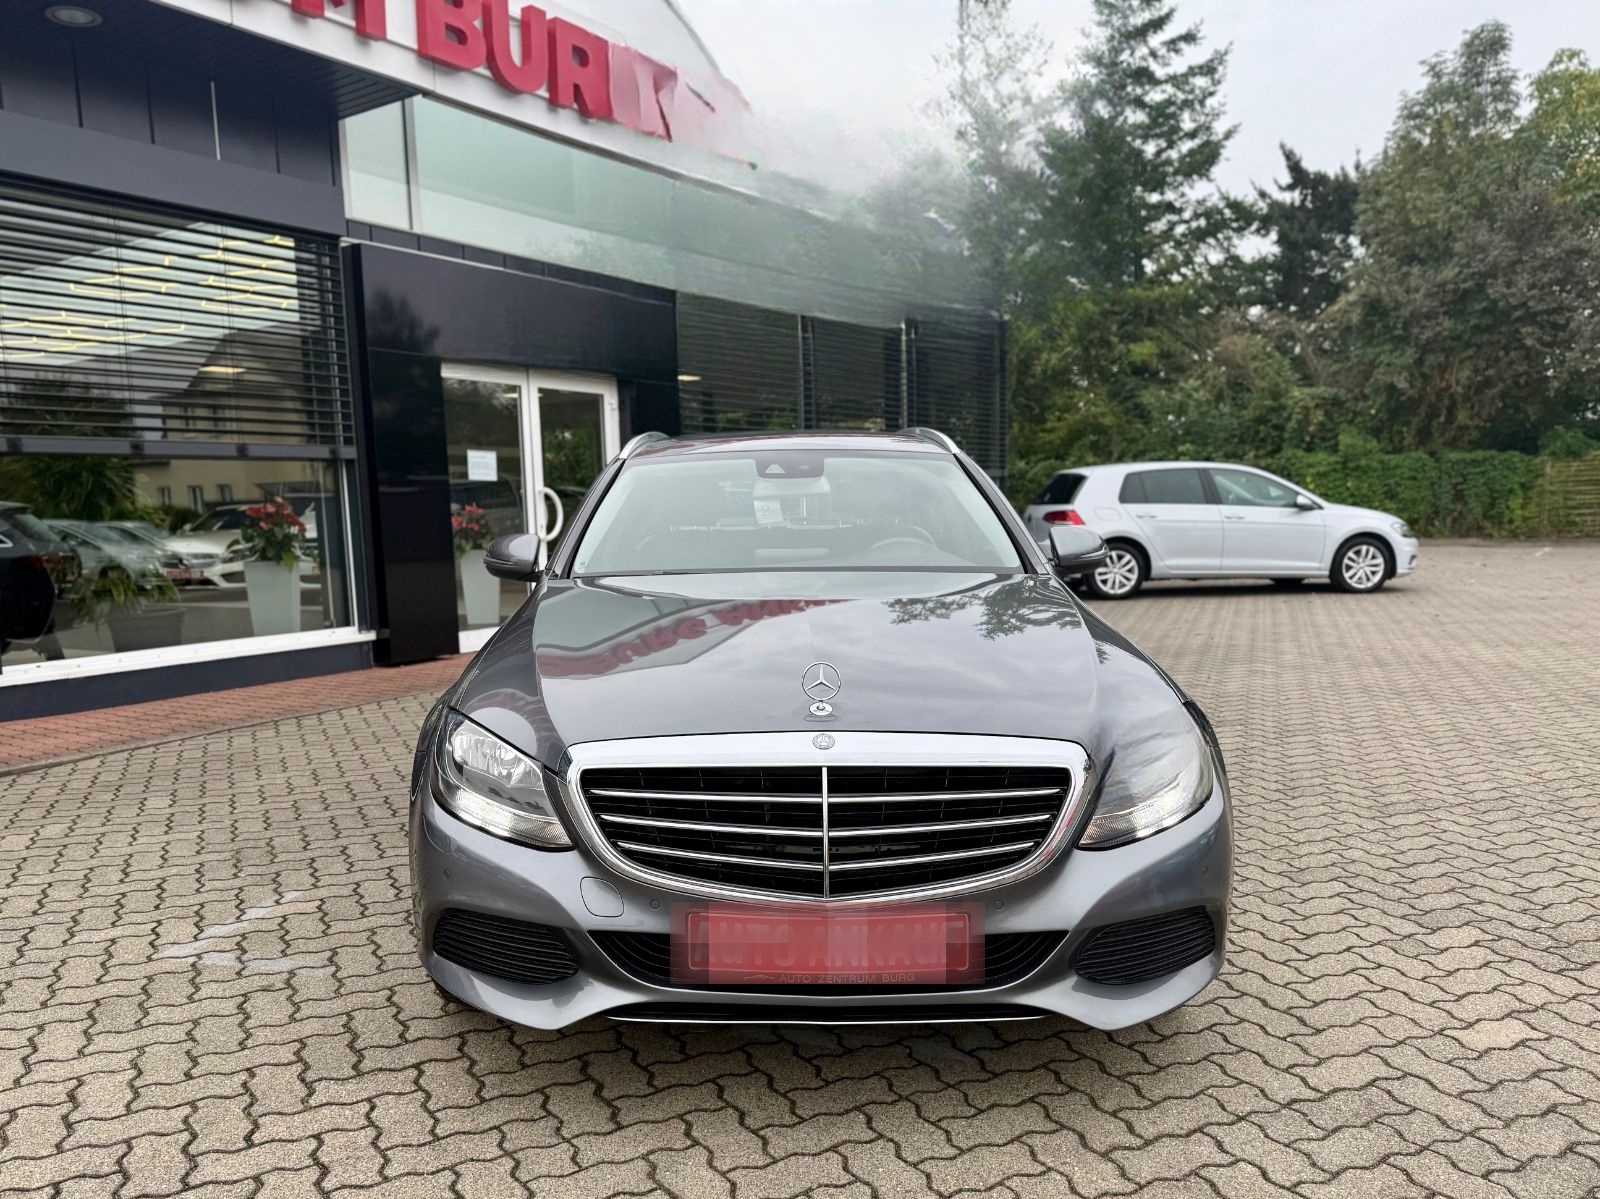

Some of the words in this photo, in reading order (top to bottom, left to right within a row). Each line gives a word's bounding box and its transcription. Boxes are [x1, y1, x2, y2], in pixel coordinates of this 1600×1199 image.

[694, 921, 797, 967] AUTO
[779, 974, 812, 983] AUTO
[818, 974, 876, 984] ZENTRUM
[882, 973, 915, 983] BURG
